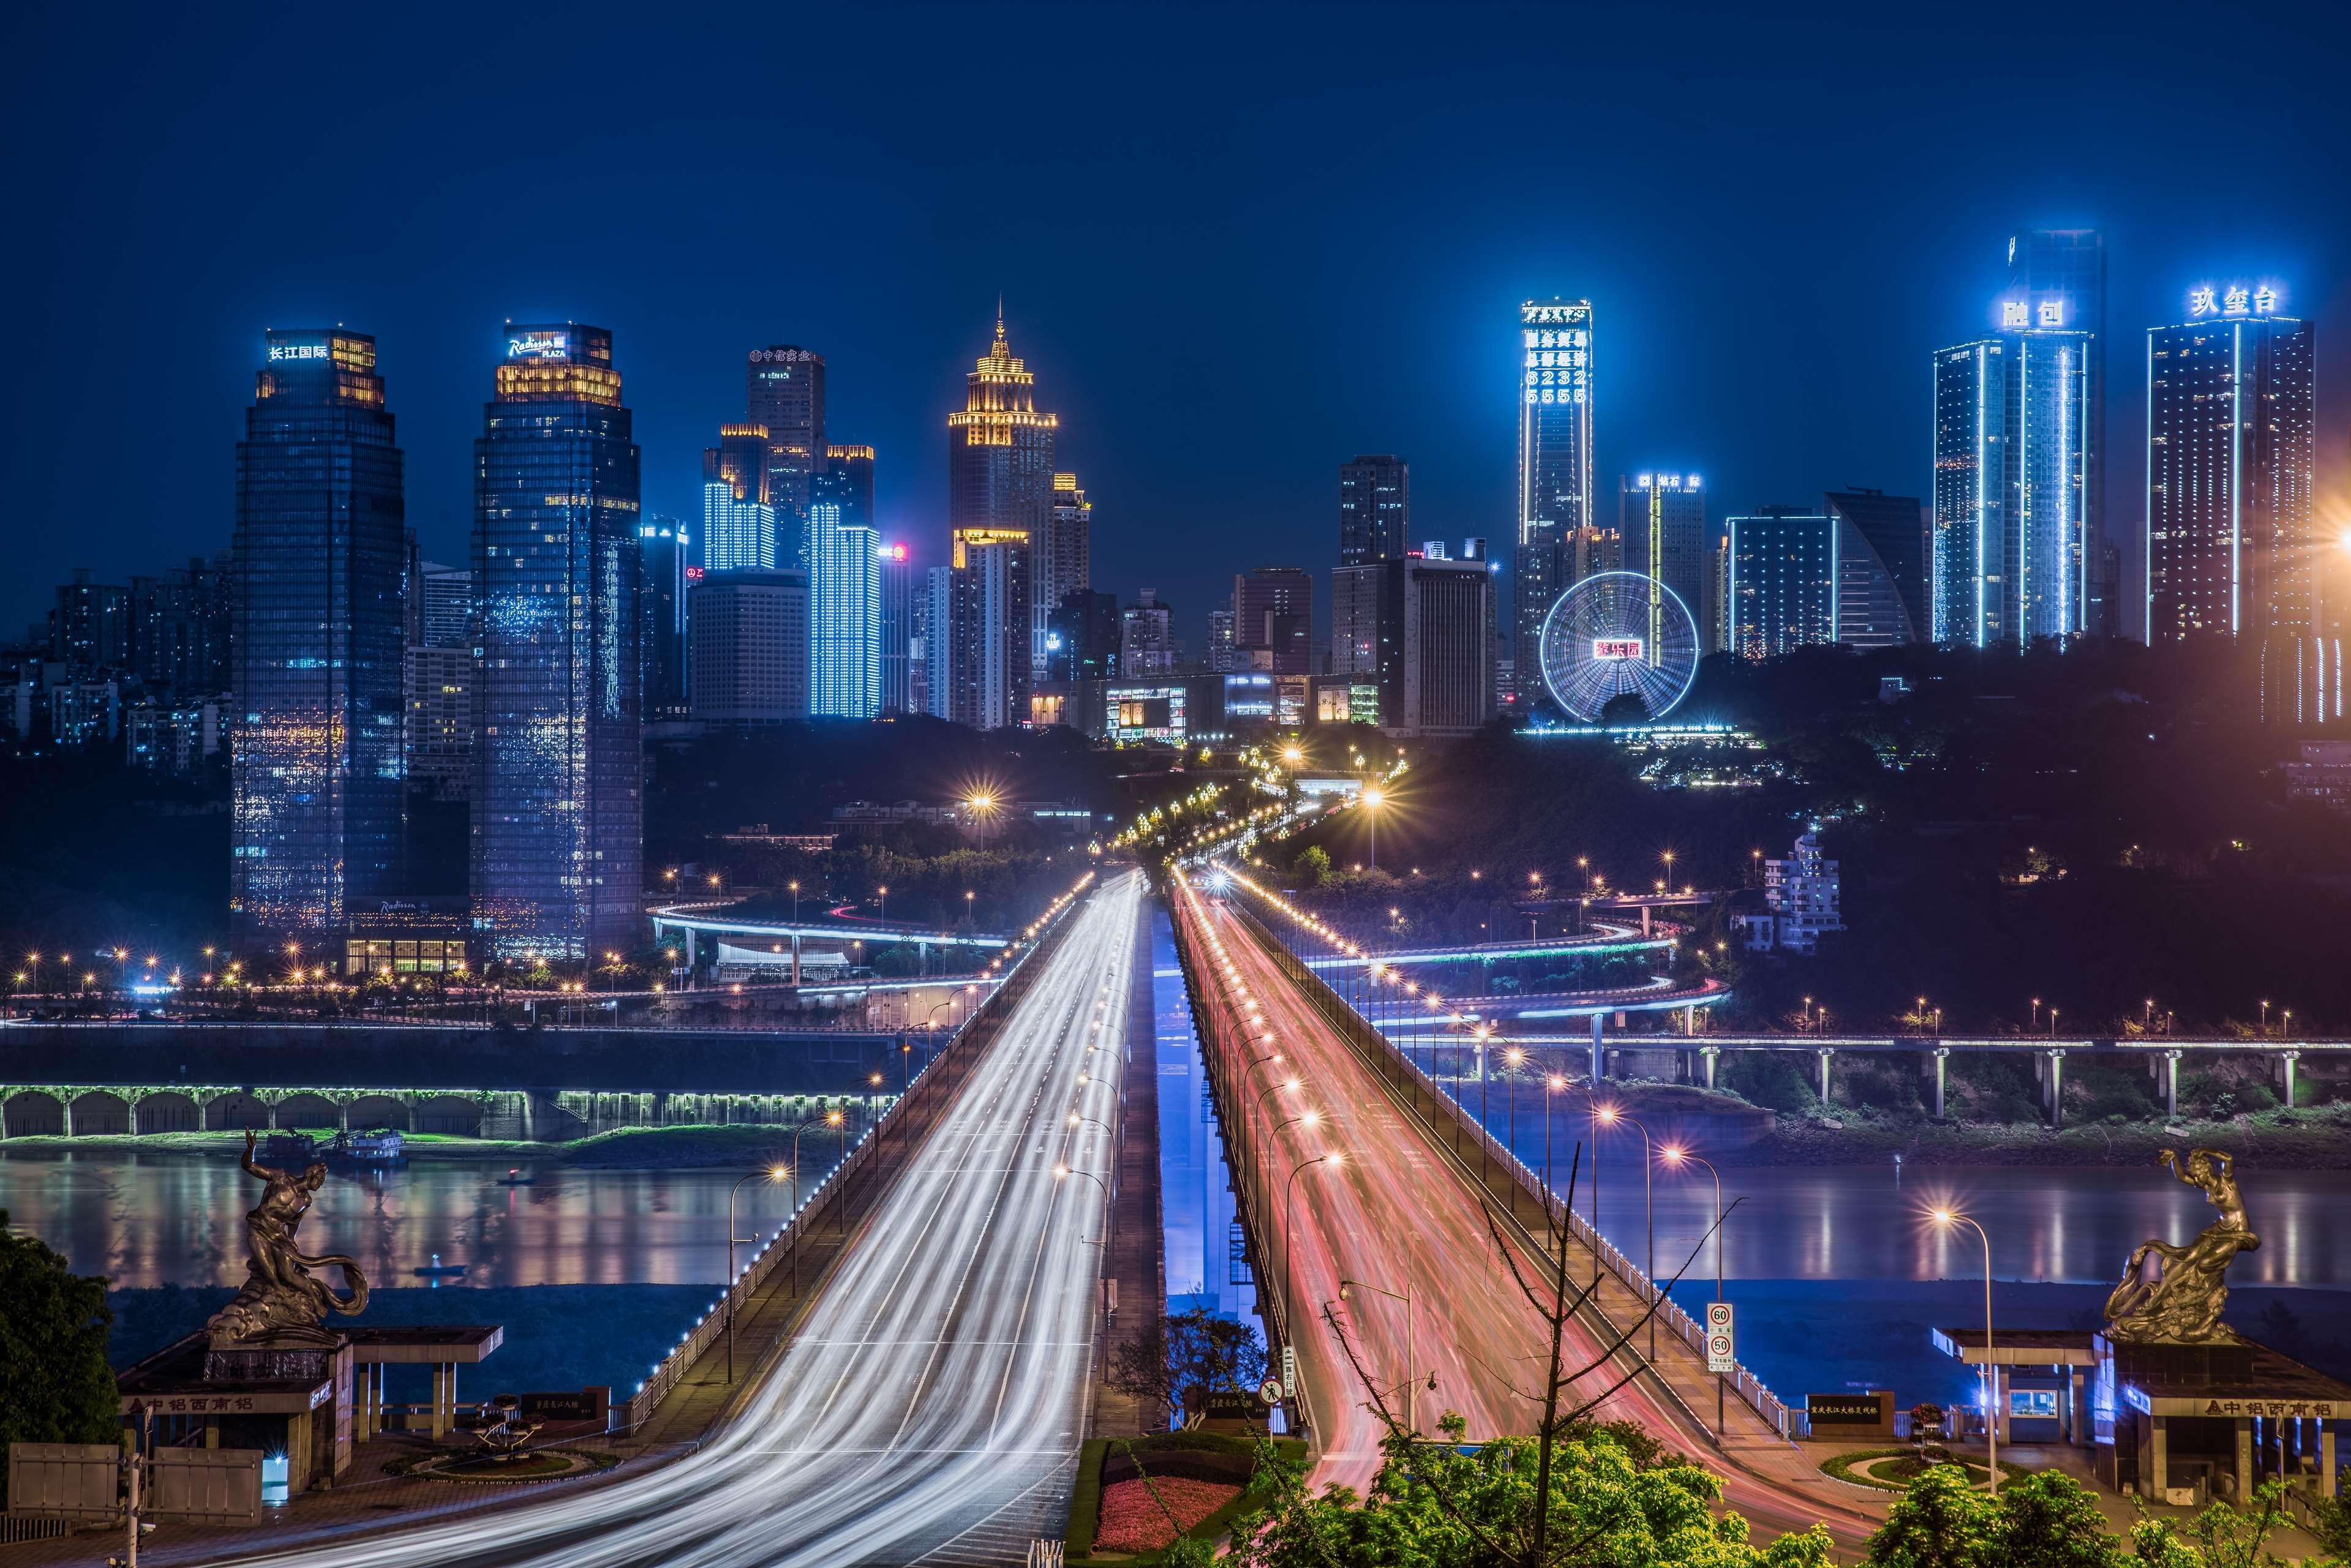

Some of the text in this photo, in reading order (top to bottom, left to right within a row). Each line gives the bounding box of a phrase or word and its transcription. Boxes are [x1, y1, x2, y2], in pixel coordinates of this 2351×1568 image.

[2191, 286, 2276, 316] 玖玺台
[2003, 301, 2063, 326] 融创
[270, 346, 328, 359] 长江国际
[509, 336, 553, 356] Radisson
[763, 349, 810, 361] 中信实业
[1527, 370, 1586, 386] 6232
[1526, 389, 1586, 403] 5555
[1597, 642, 1639, 658] 游乐园
[380, 900, 416, 913] Radisson
[1714, 1311, 1726, 1319] 60
[1715, 1341, 1727, 1350] 50
[2224, 1401, 2332, 1416] 中铝西南铝
